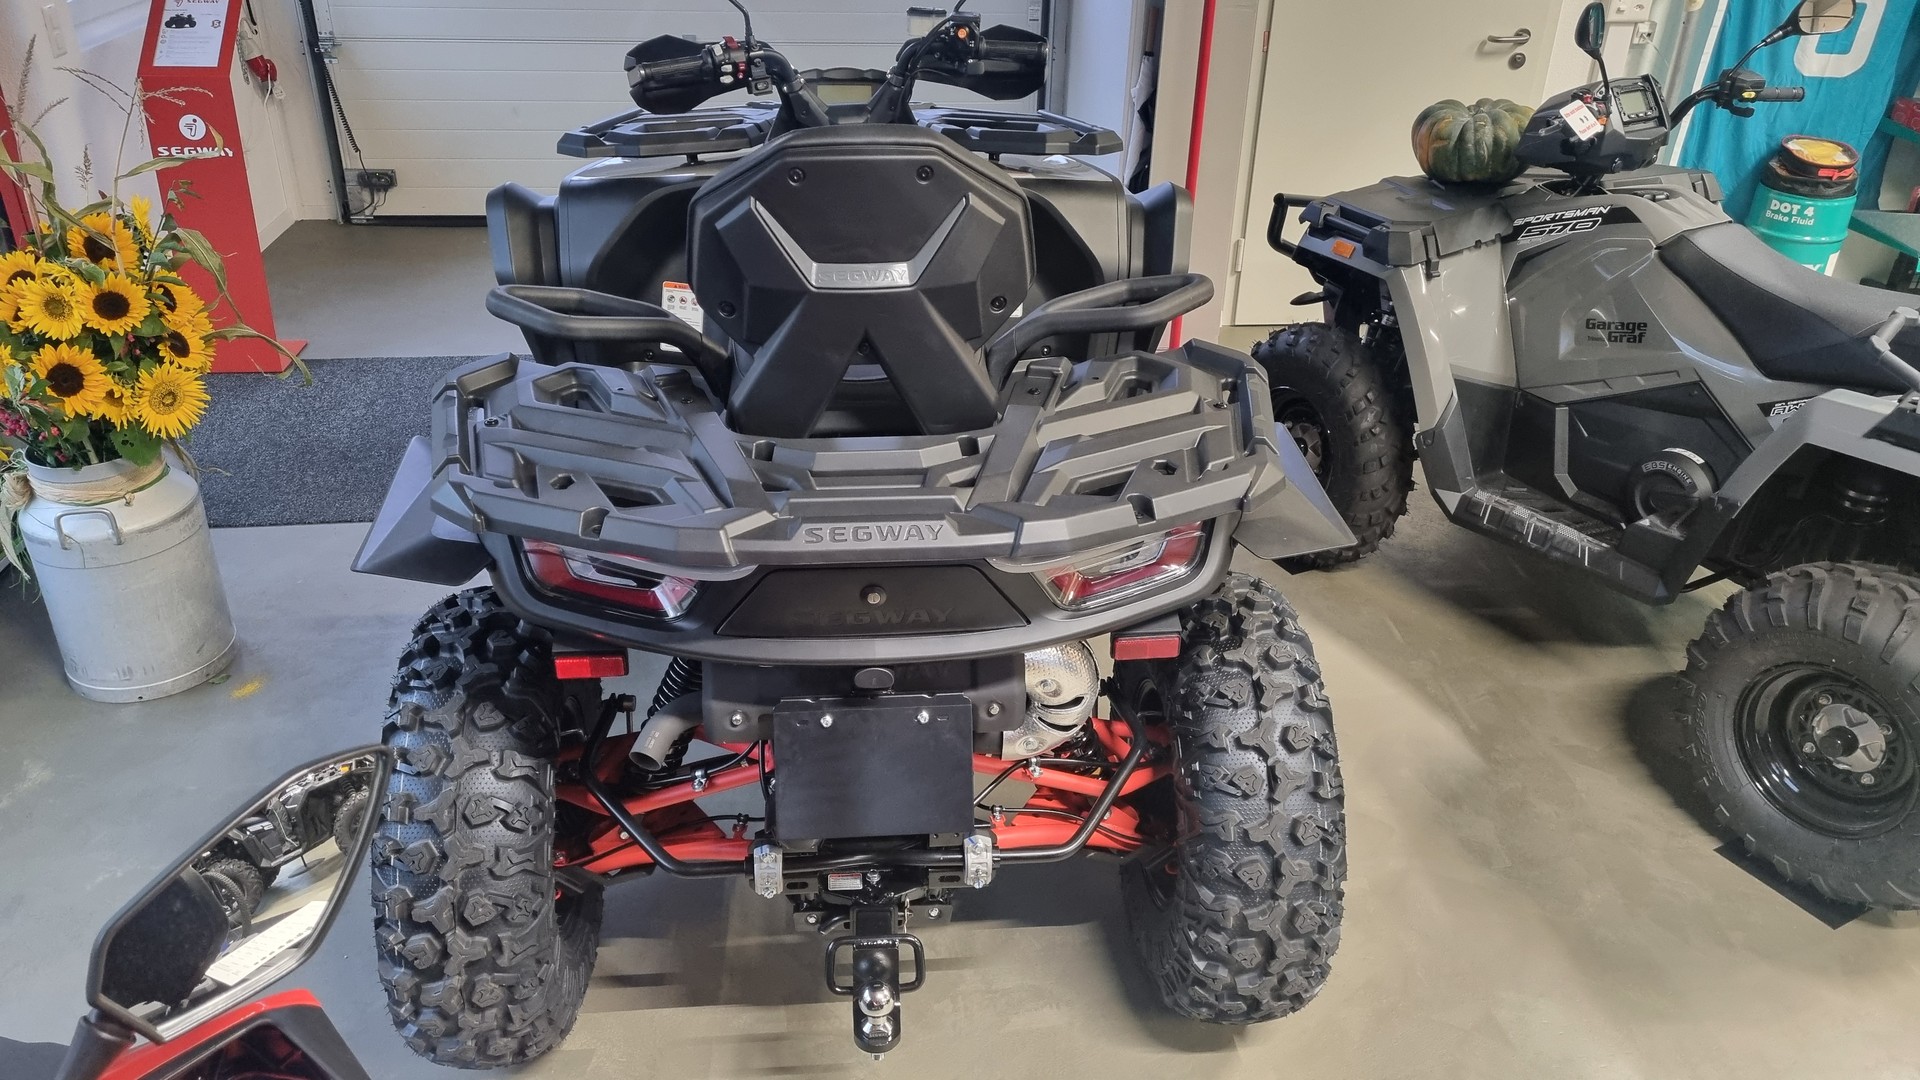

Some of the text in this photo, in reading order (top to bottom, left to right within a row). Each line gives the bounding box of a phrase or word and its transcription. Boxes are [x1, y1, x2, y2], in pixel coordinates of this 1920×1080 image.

[1513, 205, 1612, 226] SPORTSMAN
[1770, 199, 1815, 217] DOT 4
[1765, 209, 1815, 226] Brake Fluid
[1516, 217, 1602, 240] 570
[818, 269, 907, 283] SEGWAY
[1585, 318, 1648, 334] Garage
[1607, 331, 1647, 344] Graf
[1769, 402, 1806, 417] AW
[1642, 461, 1693, 484] EBS ENGINE
[803, 524, 944, 544] SEGWAY
[794, 606, 954, 626] EGWAY
